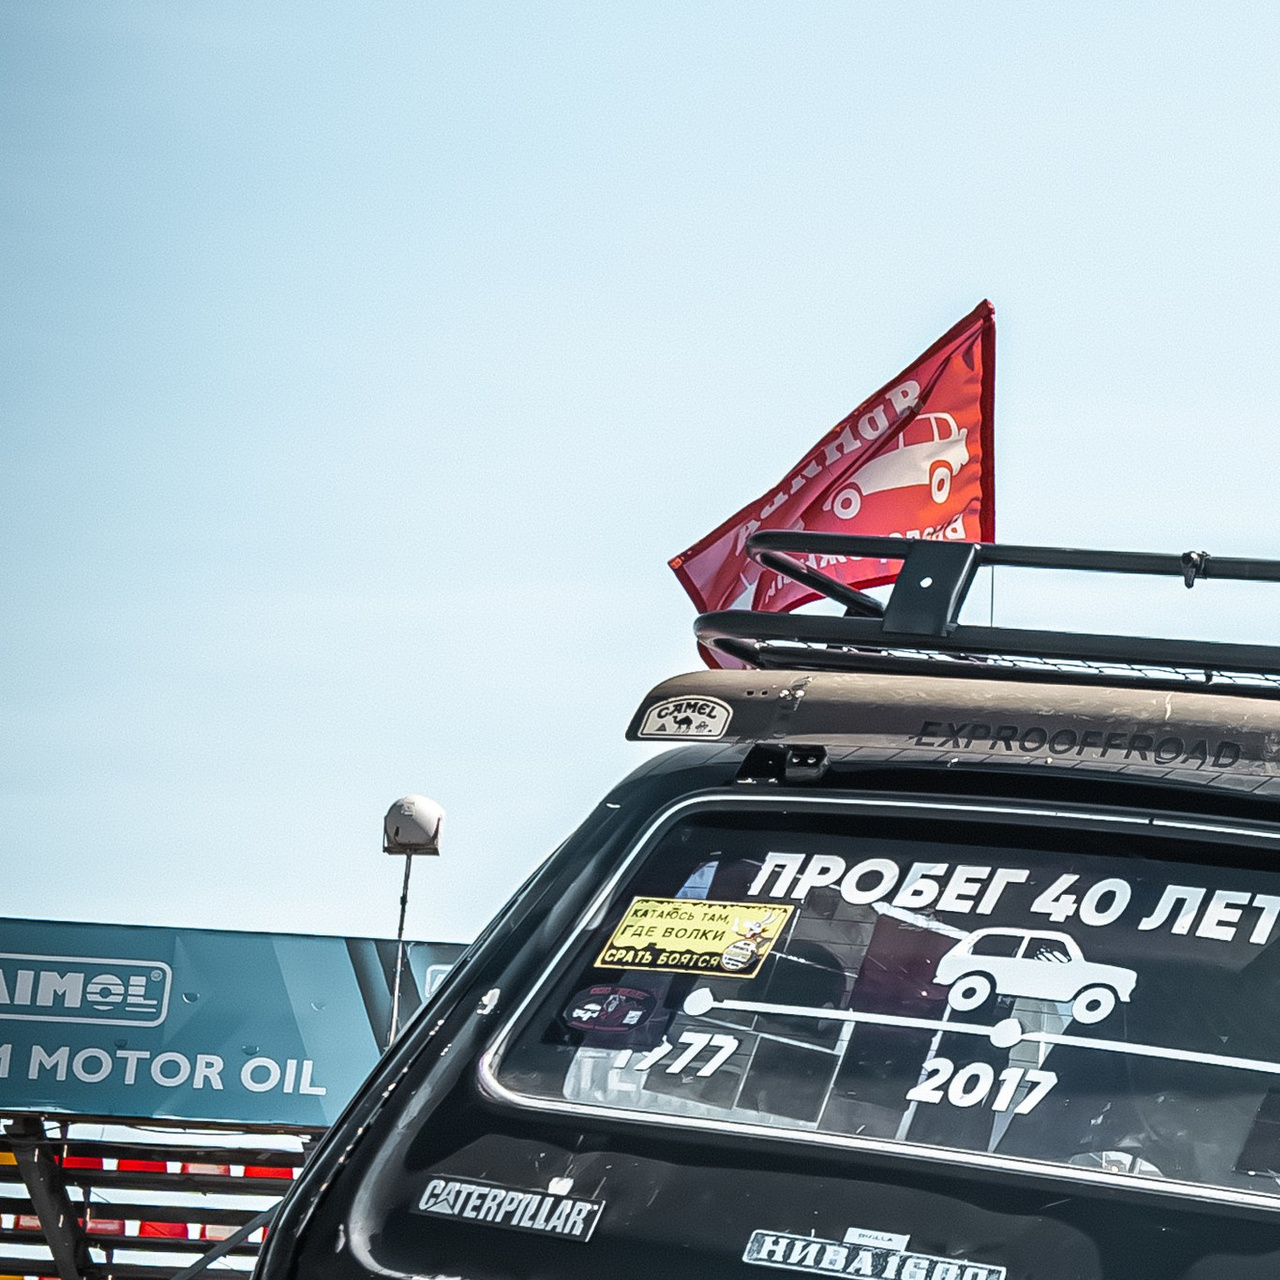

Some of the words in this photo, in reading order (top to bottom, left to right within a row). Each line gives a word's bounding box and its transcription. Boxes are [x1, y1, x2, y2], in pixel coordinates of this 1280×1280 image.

[657, 701, 717, 719] CAMEL
[914, 720, 1242, 769] EXPROOFFROAD
[748, 851, 1030, 916] ПРОБЕГ
[1031, 873, 1132, 927] 40
[604, 948, 653, 965] СРАТЬ
[656, 952, 721, 969] БОЯТСЯ
[620, 925, 658, 937] ГДЕ
[662, 927, 726, 942] ВОЛКИ
[28, 1045, 224, 1090] MOTOR
[240, 1054, 327, 1096] OIL
[906, 1057, 1059, 1115] 2017
[419, 1179, 592, 1236] CATERPILLAR
